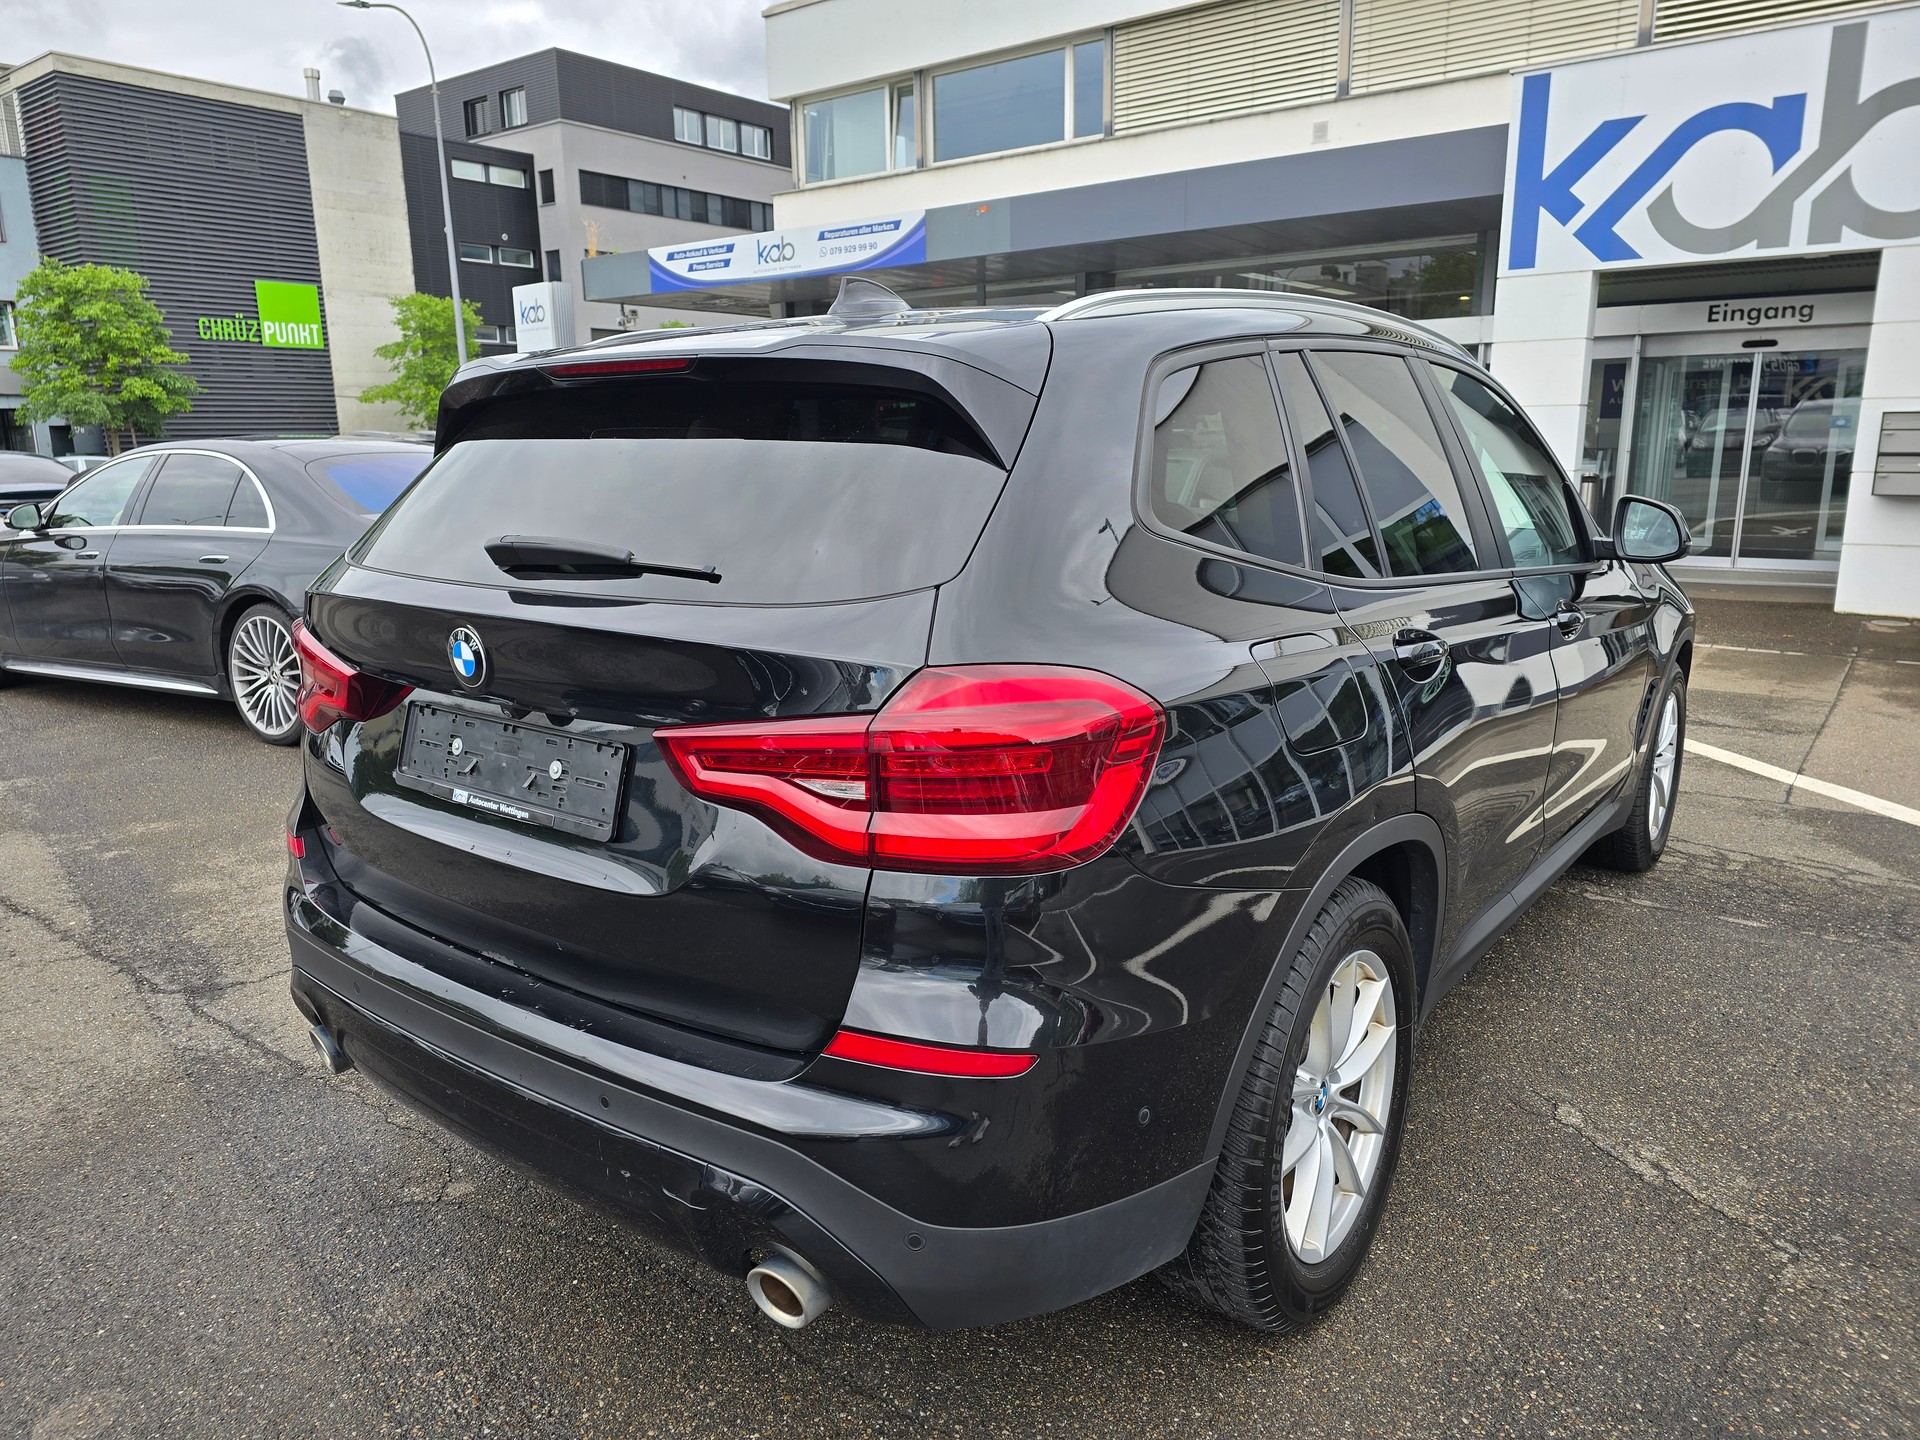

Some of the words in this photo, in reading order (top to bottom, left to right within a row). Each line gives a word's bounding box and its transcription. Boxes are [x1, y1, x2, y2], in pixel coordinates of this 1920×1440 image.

[1508, 20, 1920, 271] kab
[823, 227, 859, 240] Reparaturen
[859, 225, 872, 235] aller
[872, 222, 895, 233] Marken
[757, 235, 796, 265] kab
[829, 246, 843, 256] 079
[844, 244, 857, 254] 929
[858, 243, 867, 252] 99
[868, 241, 878, 250] 90
[692, 260, 725, 271] Pneu-Service
[519, 297, 546, 325] kab
[1707, 302, 1815, 326] Eingang
[198, 312, 260, 343] CHRÜZ
[263, 320, 319, 346] PUNKT
[468, 795, 499, 810] Autocenter
[500, 803, 529, 819] Wettingen
